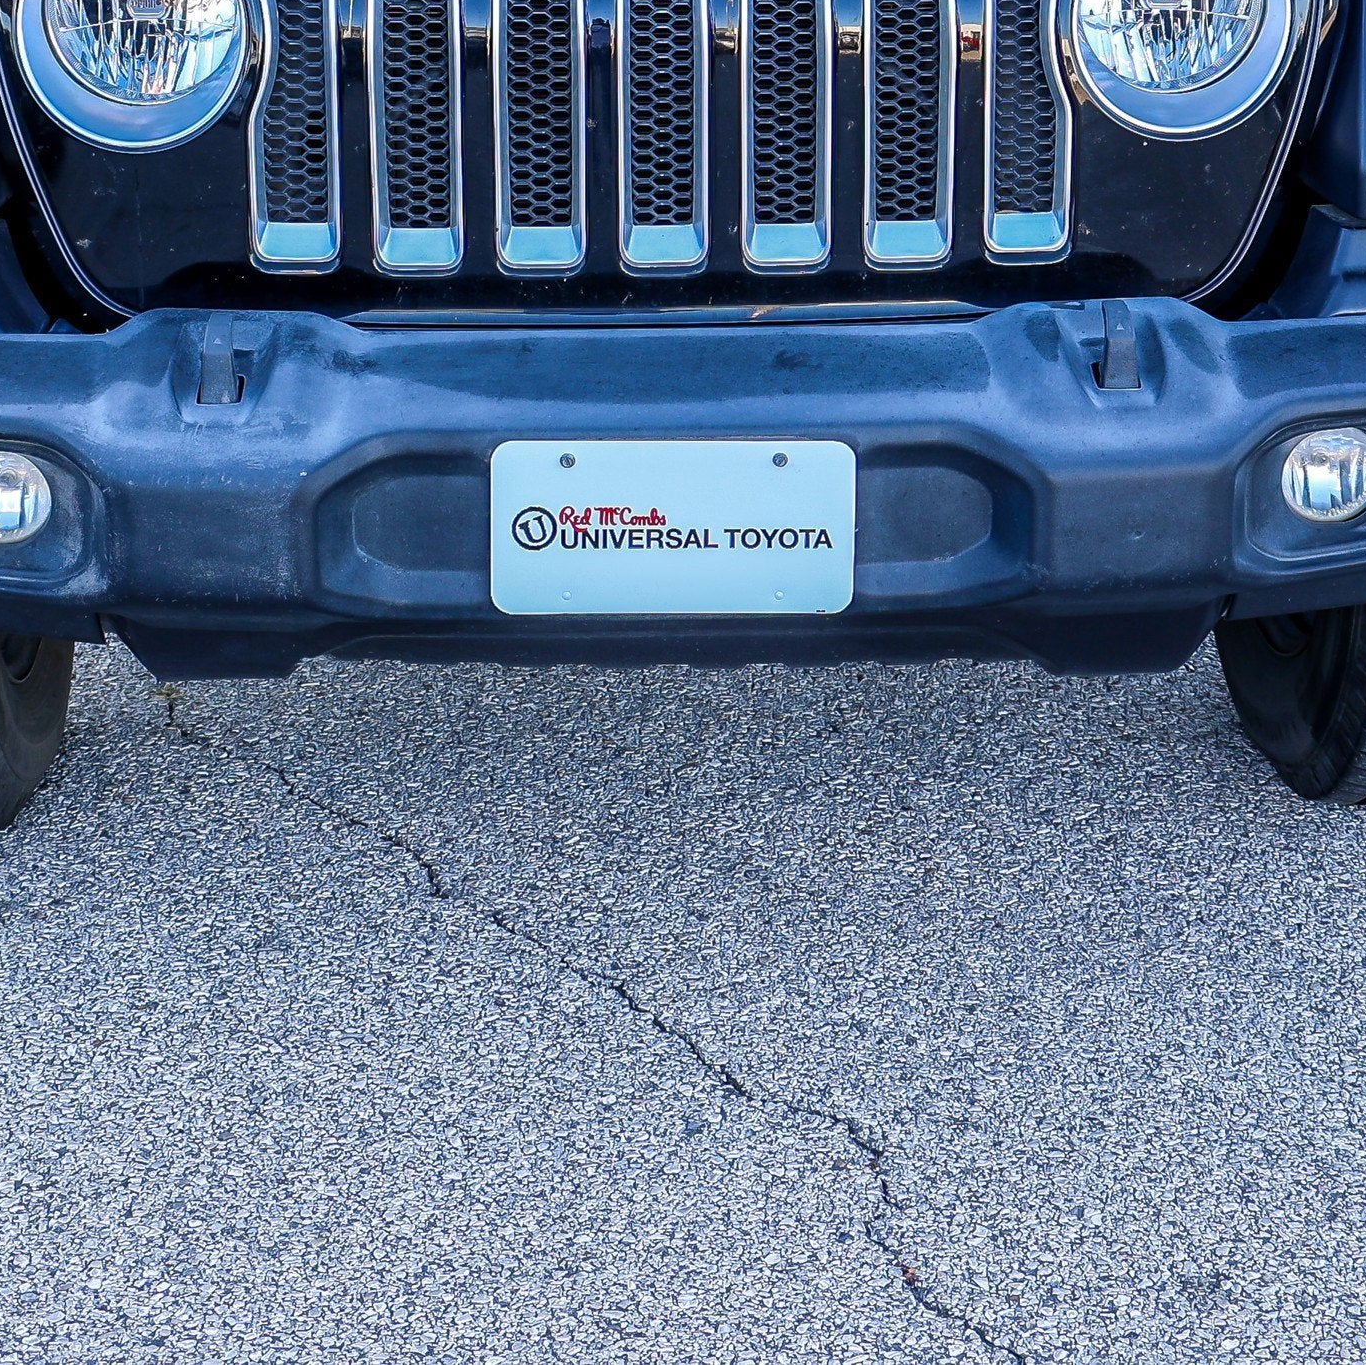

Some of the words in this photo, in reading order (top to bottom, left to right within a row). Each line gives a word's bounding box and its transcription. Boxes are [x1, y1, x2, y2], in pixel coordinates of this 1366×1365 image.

[559, 506, 592, 532] Red
[594, 506, 667, 526] McCombs
[560, 528, 719, 550] UNIVERSAL
[723, 528, 833, 550] TOYOTA
